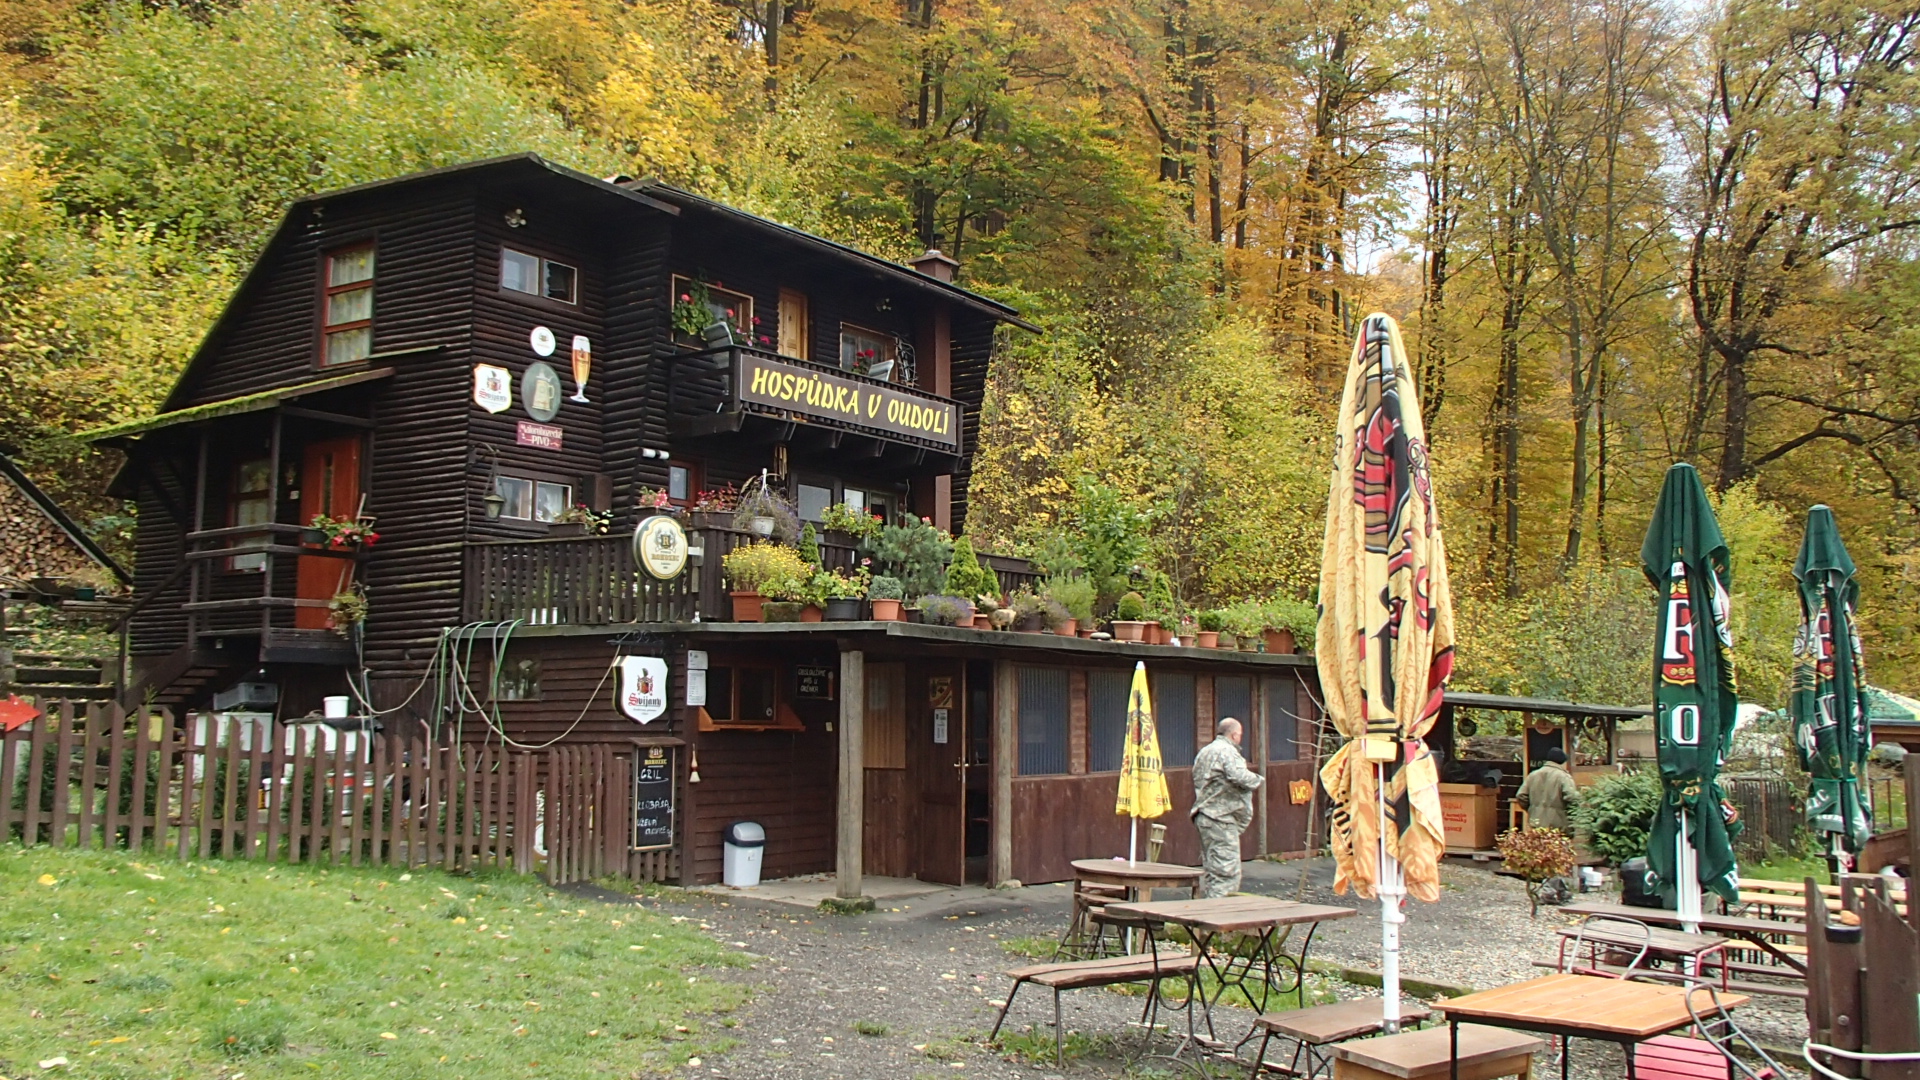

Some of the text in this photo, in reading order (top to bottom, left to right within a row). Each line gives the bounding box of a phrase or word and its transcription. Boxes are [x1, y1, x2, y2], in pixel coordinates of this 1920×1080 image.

[751, 367, 950, 436] HOSPŮDKA V OUDOLÍ
[531, 434, 550, 447] PIVO
[628, 693, 662, 708] Svijany
[1294, 785, 1306, 800] WC
